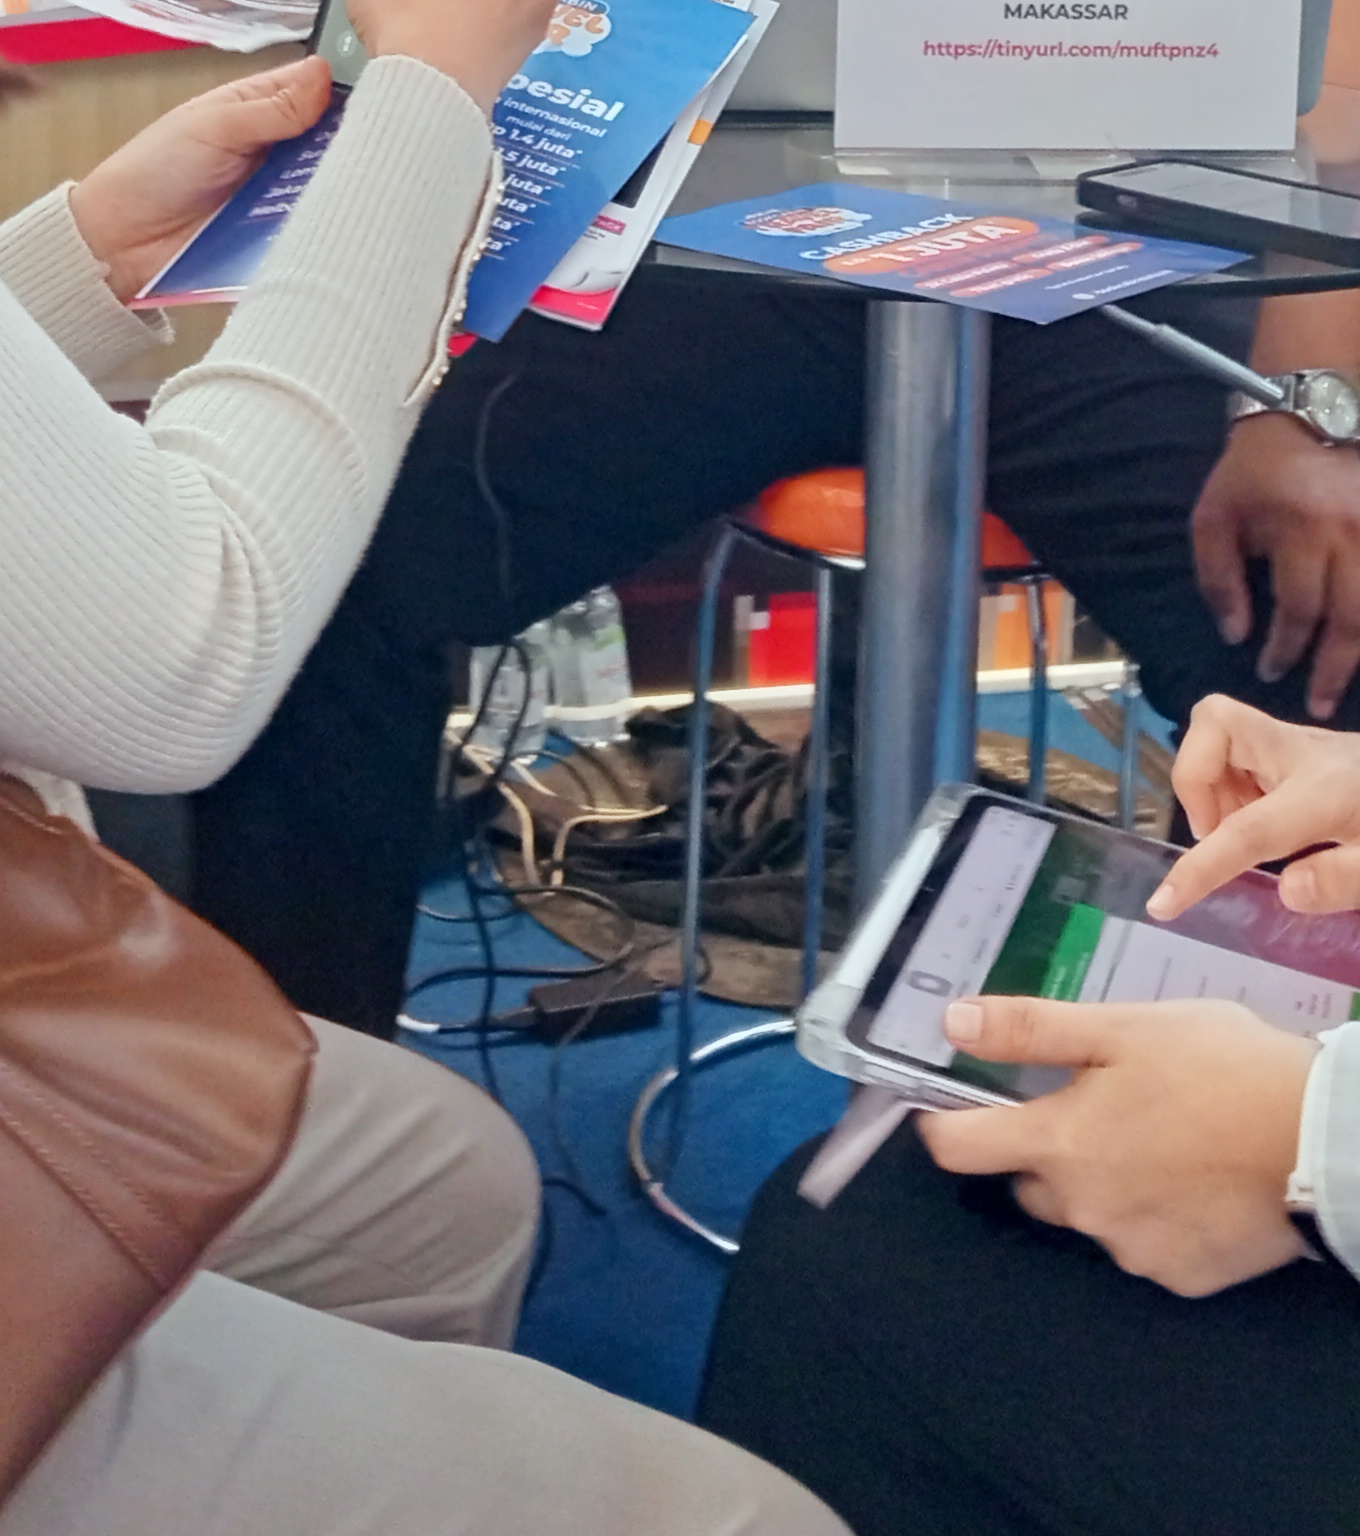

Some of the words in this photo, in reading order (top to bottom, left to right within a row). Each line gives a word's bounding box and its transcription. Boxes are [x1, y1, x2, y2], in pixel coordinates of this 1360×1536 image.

[1003, 2, 1130, 21] MAKASSAR
[922, 38, 1220, 61] https://tinyurl.com/muftpnz4
[799, 212, 975, 261] CASHBACK
